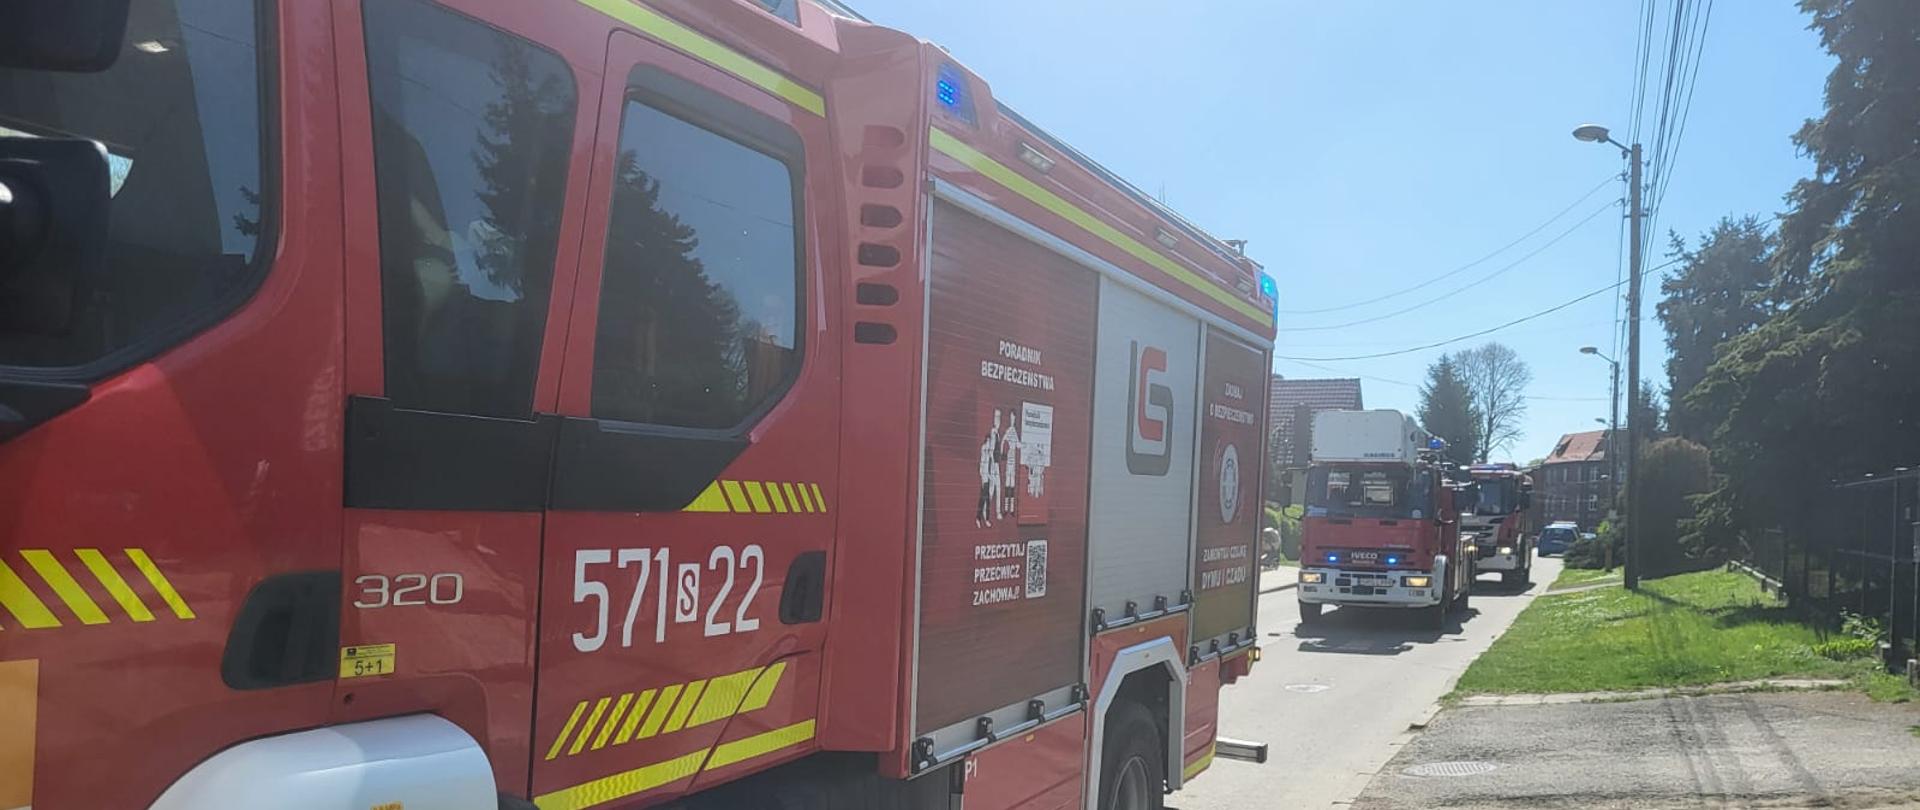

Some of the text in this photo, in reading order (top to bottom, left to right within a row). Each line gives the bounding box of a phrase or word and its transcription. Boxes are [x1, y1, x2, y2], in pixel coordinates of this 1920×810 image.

[999, 340, 1041, 365] PORADNIK
[975, 542, 1025, 560] PRZECZYTAJ
[1351, 551, 1378, 559] IVECO
[353, 573, 463, 608] 320
[572, 544, 765, 652] 571 S 22
[354, 659, 383, 676] 5+1
[964, 757, 978, 782] P1
